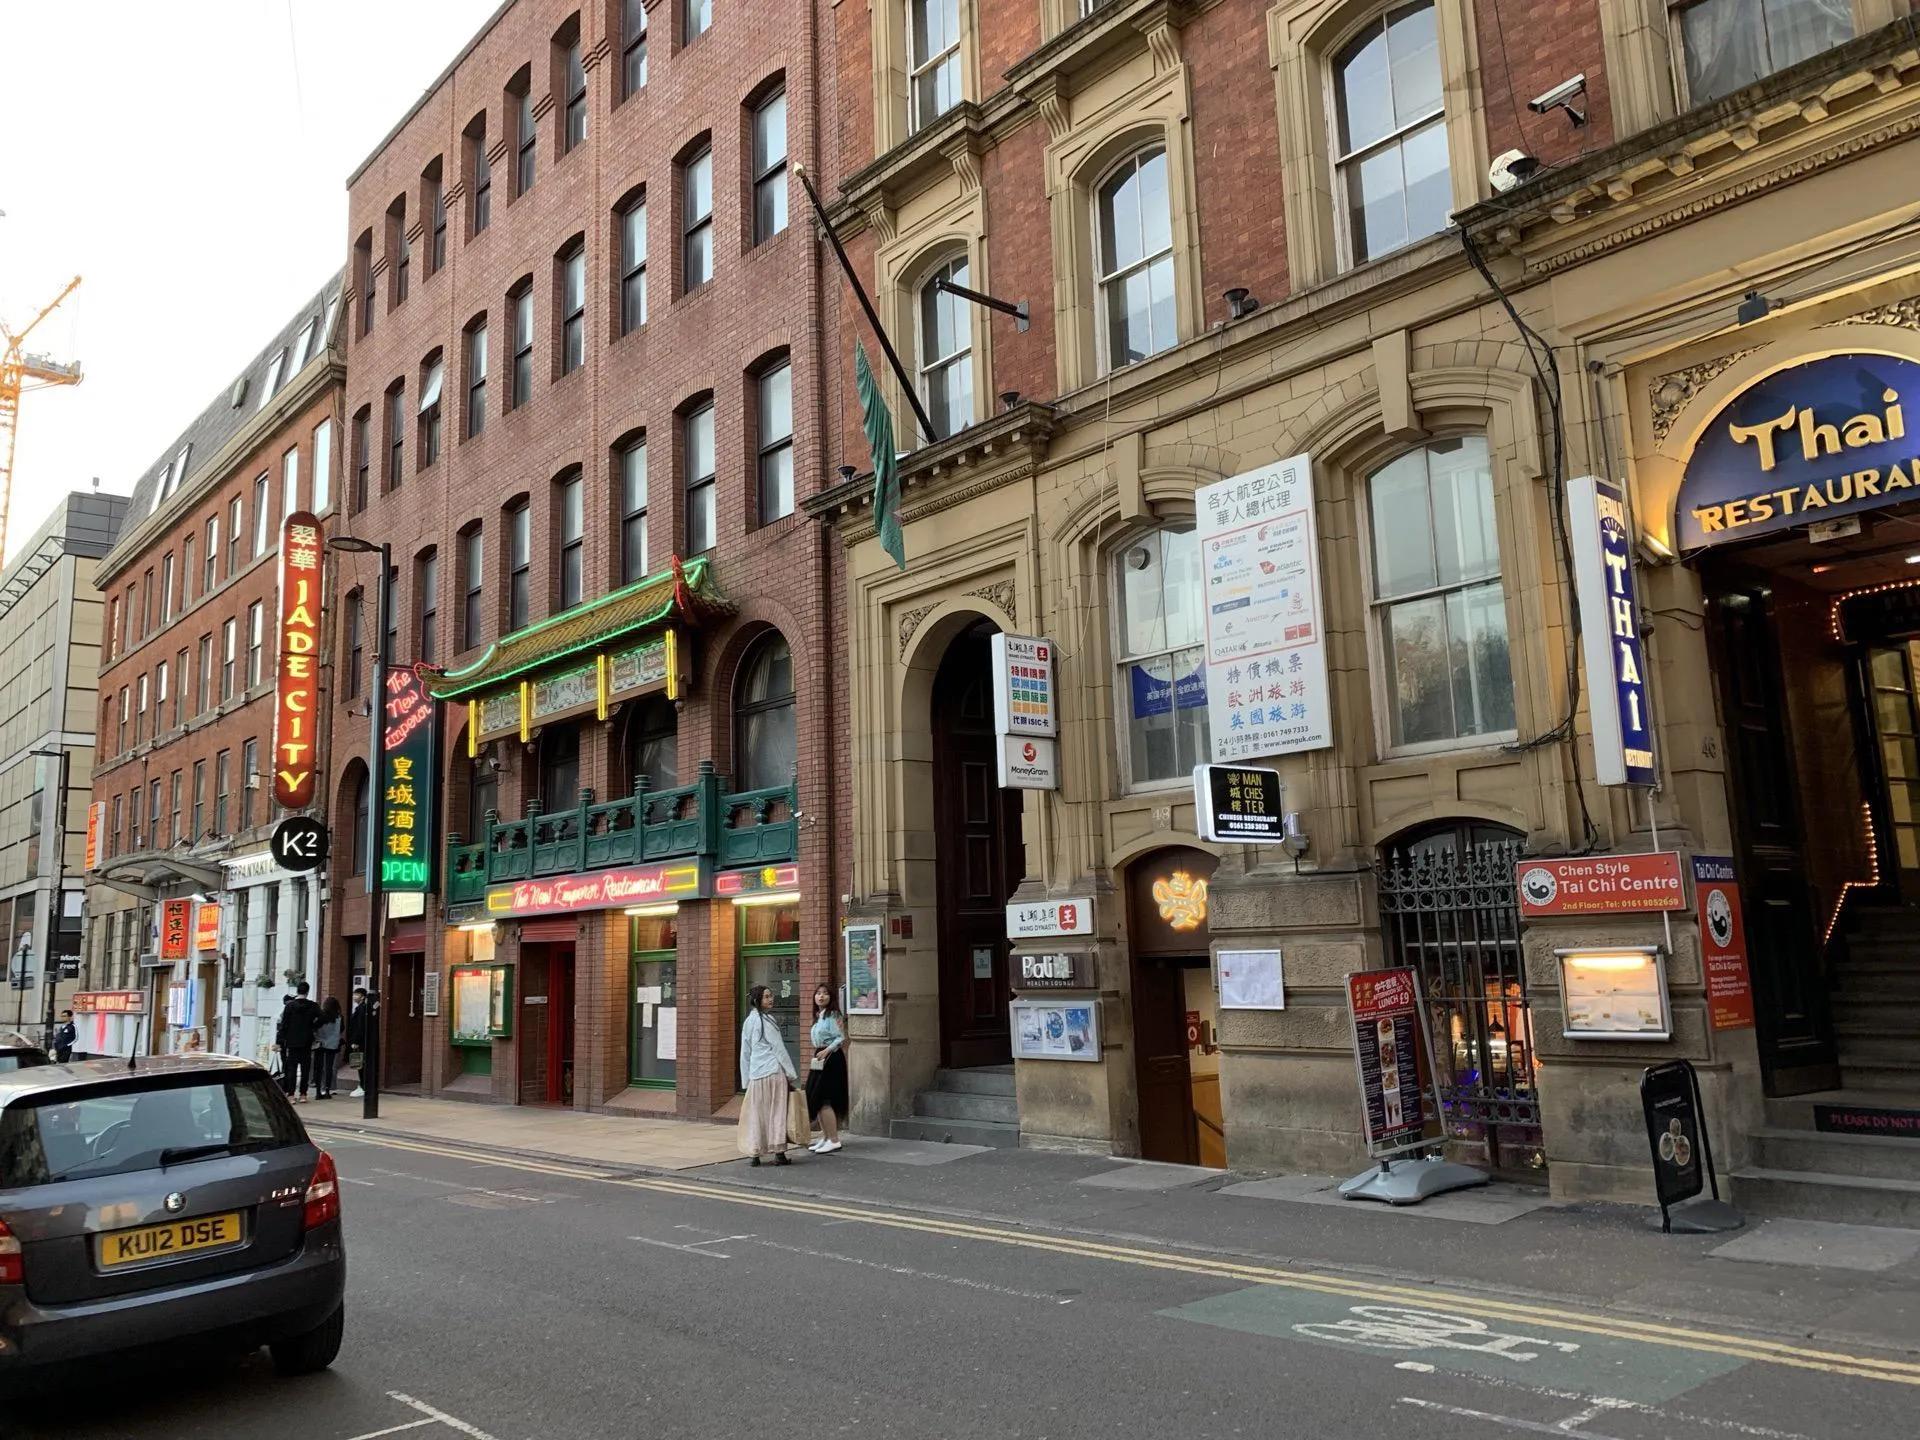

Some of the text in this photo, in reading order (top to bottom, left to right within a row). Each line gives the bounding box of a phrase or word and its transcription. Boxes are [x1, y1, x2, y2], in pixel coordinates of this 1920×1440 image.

[1729, 387, 1905, 471] Thai
[1207, 467, 1297, 509] 各大航空公司
[1216, 490, 1292, 526] 華人總代理
[286, 579, 315, 678] JADE
[1605, 548, 1642, 731] THAI
[1227, 653, 1302, 683] 特價機票
[386, 671, 411, 693] The
[386, 689, 418, 718] New
[385, 704, 432, 750] Emperor
[1280, 728, 1292, 736] 749
[1293, 725, 1309, 733] 7333
[278, 690, 309, 793] CITY
[1011, 766, 1049, 776] MoneyGram
[1242, 773, 1262, 785] MAN
[1244, 787, 1264, 800] CHES
[386, 756, 416, 857] 皇城酒樓
[1152, 806, 1170, 820] 48
[1246, 801, 1265, 814] TER
[382, 860, 426, 883] OPEN
[1558, 862, 1630, 877] Chen Style
[1696, 863, 1734, 879] Tai Chi Centre
[512, 870, 667, 909] The New Emperor Restaurant
[1560, 876, 1679, 894] Tai Chi Centre
[1562, 902, 1577, 910] 2nd
[1605, 900, 1620, 908] Tel:
[1621, 899, 1641, 907] 0161
[1019, 923, 1057, 932] WANG DYNASTY
[59, 962, 77, 970] Free
[1022, 955, 1054, 979] Bali
[1378, 994, 1399, 1009] LUNCH
[1400, 991, 1409, 1005] £9
[1872, 1115, 1888, 1127] DO
[1890, 1116, 1914, 1128] NOT
[118, 1220, 225, 1258] KU12 DSE
